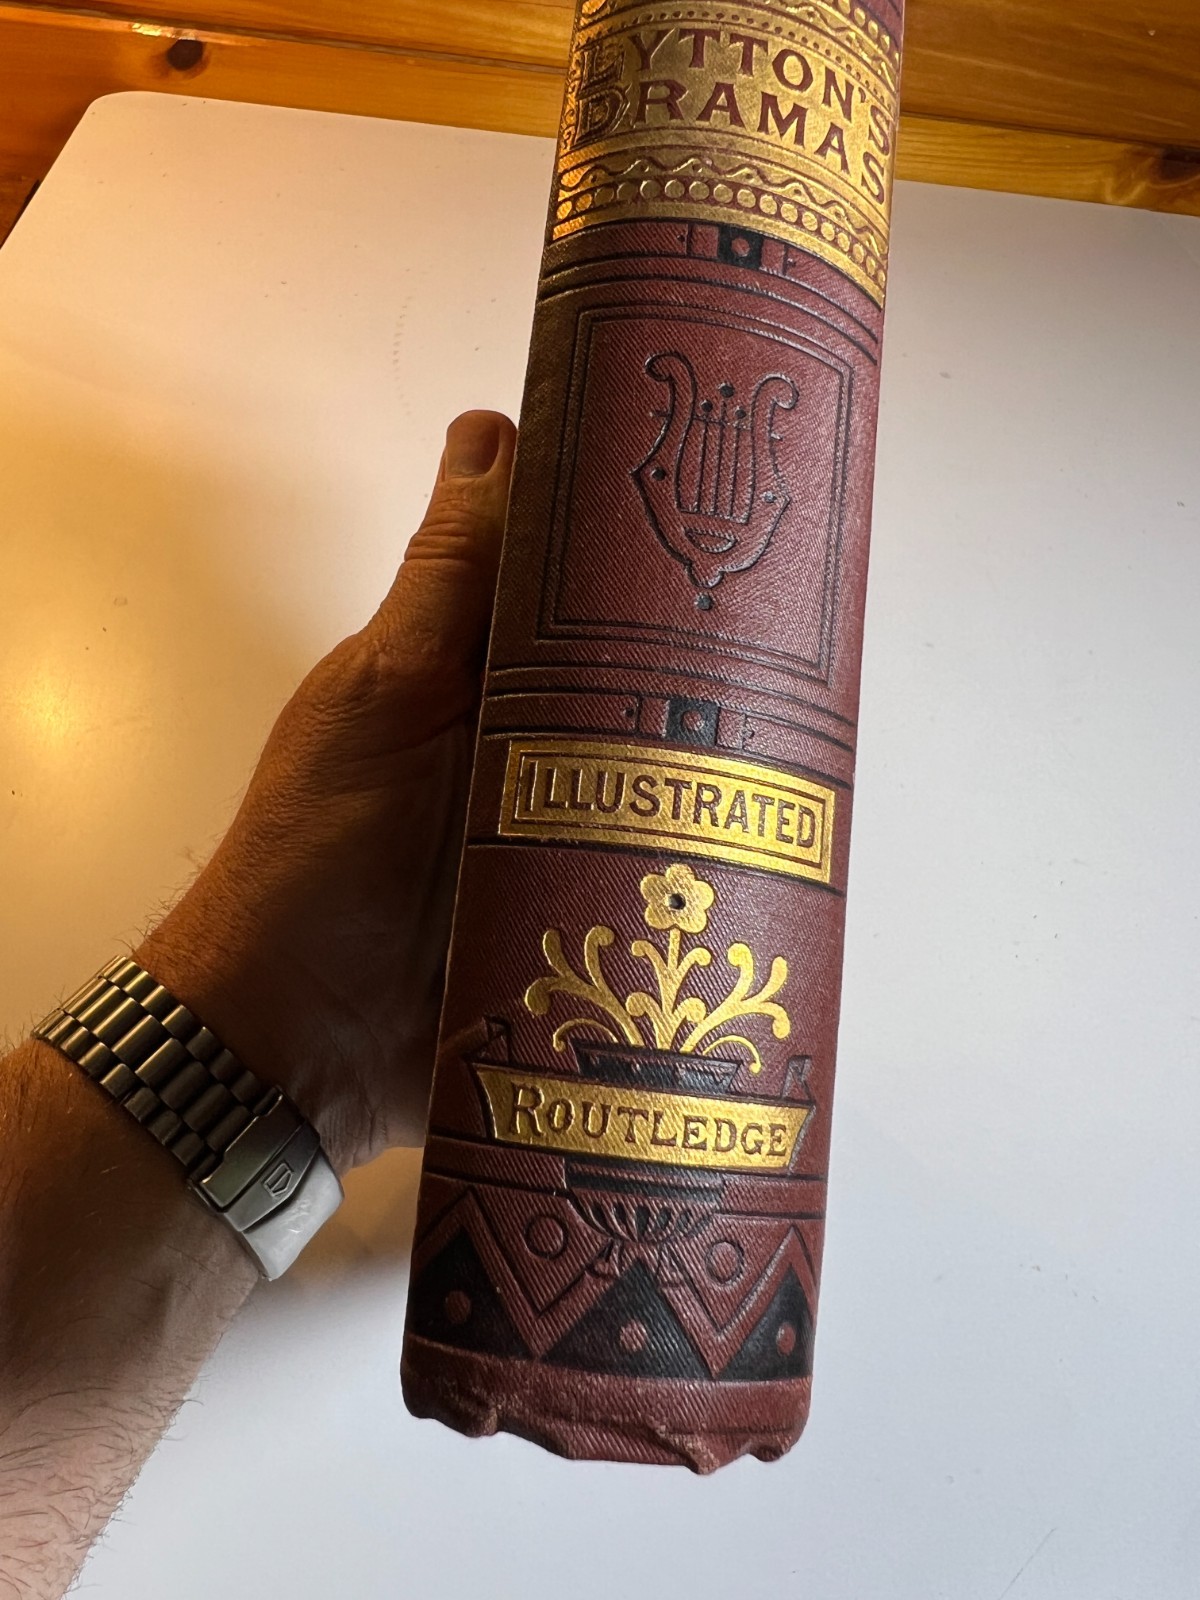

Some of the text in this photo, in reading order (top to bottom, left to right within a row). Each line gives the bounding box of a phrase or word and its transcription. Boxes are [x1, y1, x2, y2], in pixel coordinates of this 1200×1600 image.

[576, 80, 886, 205] DRAMAS
[526, 759, 817, 849] ILLUSTRATED
[509, 1081, 788, 1157] ROUTLEDGE
